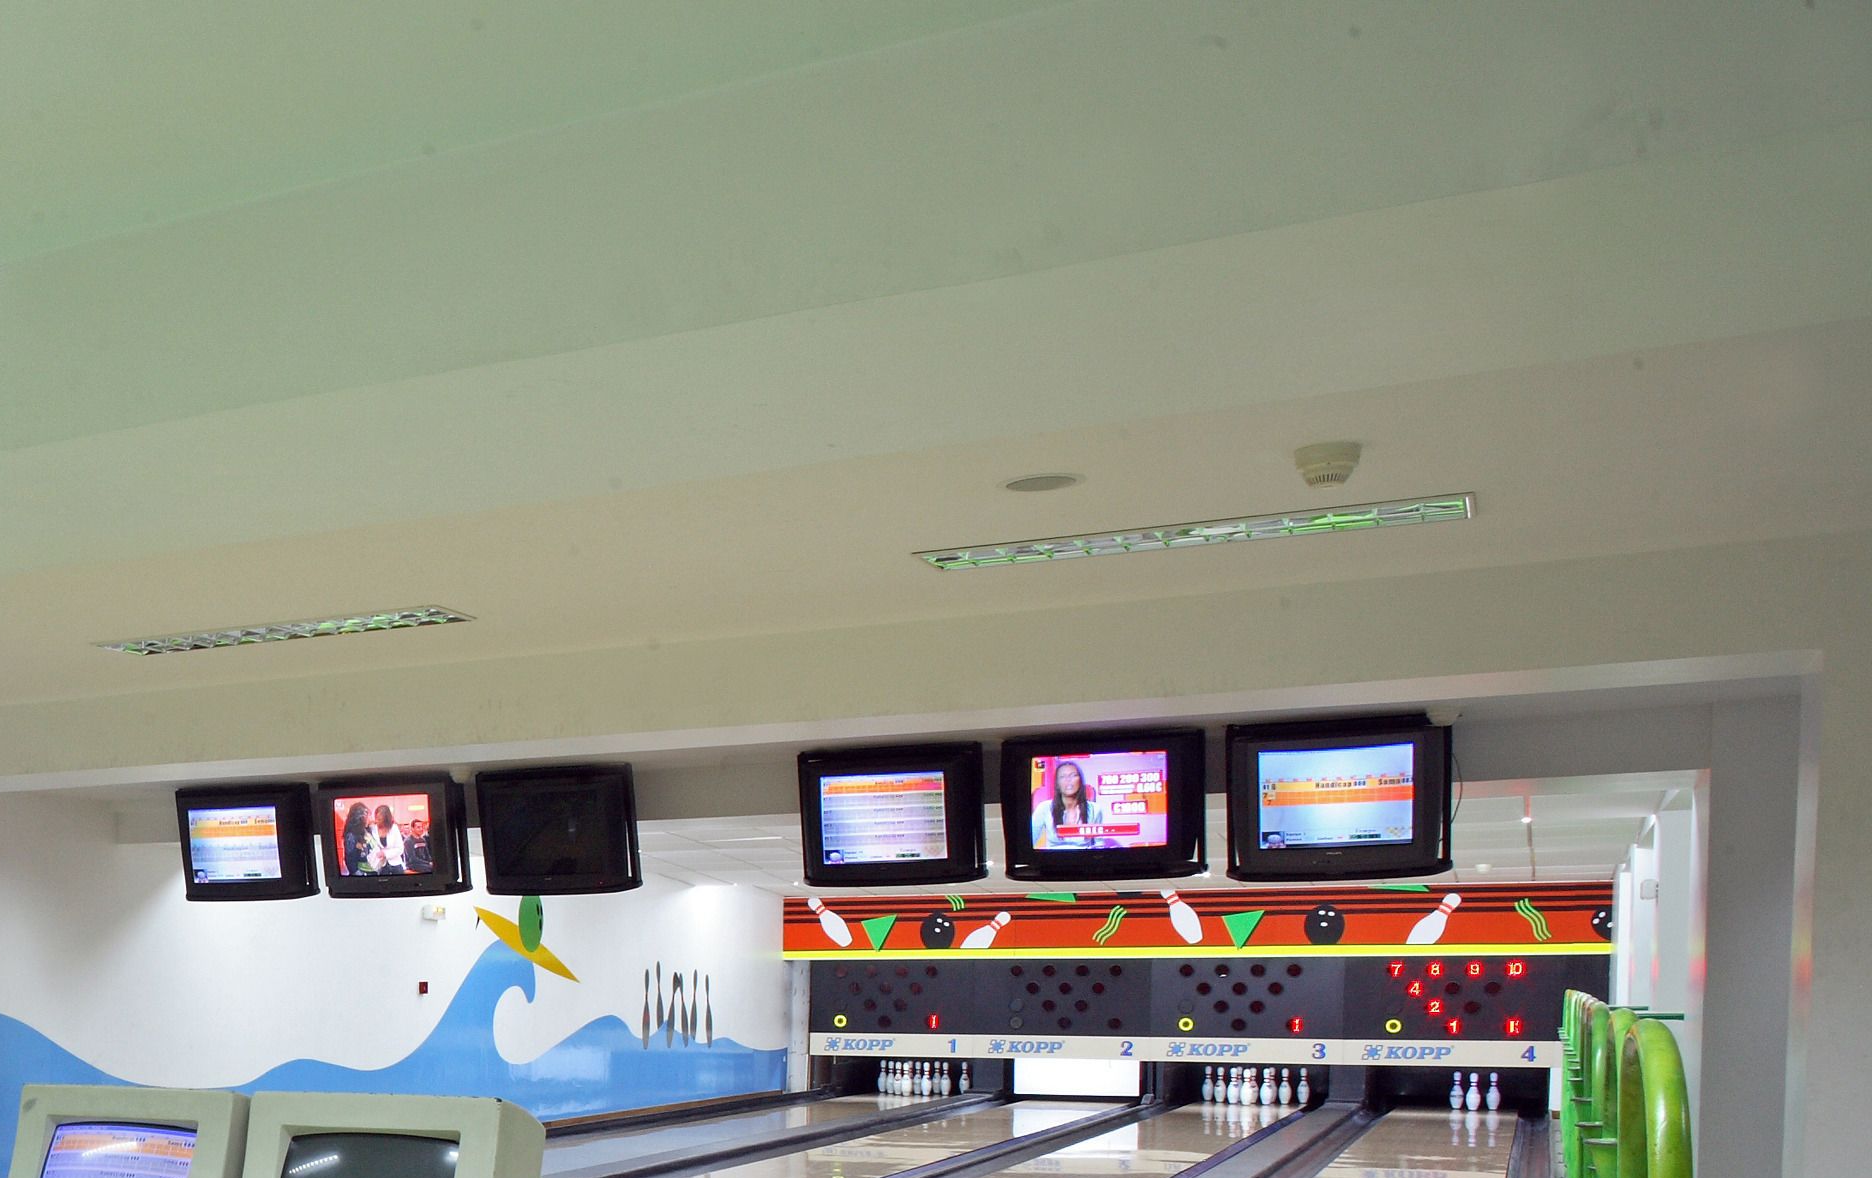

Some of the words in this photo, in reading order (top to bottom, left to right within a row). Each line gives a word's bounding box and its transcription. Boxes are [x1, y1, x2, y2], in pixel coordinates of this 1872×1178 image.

[842, 1038, 894, 1051] KOPP
[947, 1038, 957, 1054] 1
[1007, 1040, 1063, 1053] KOPP
[1120, 1040, 1134, 1056] 2
[1187, 1043, 1249, 1056] KOPP
[1312, 1043, 1326, 1059] 3
[1384, 1046, 1451, 1060] KOPP
[1521, 1046, 1536, 1062] 4
